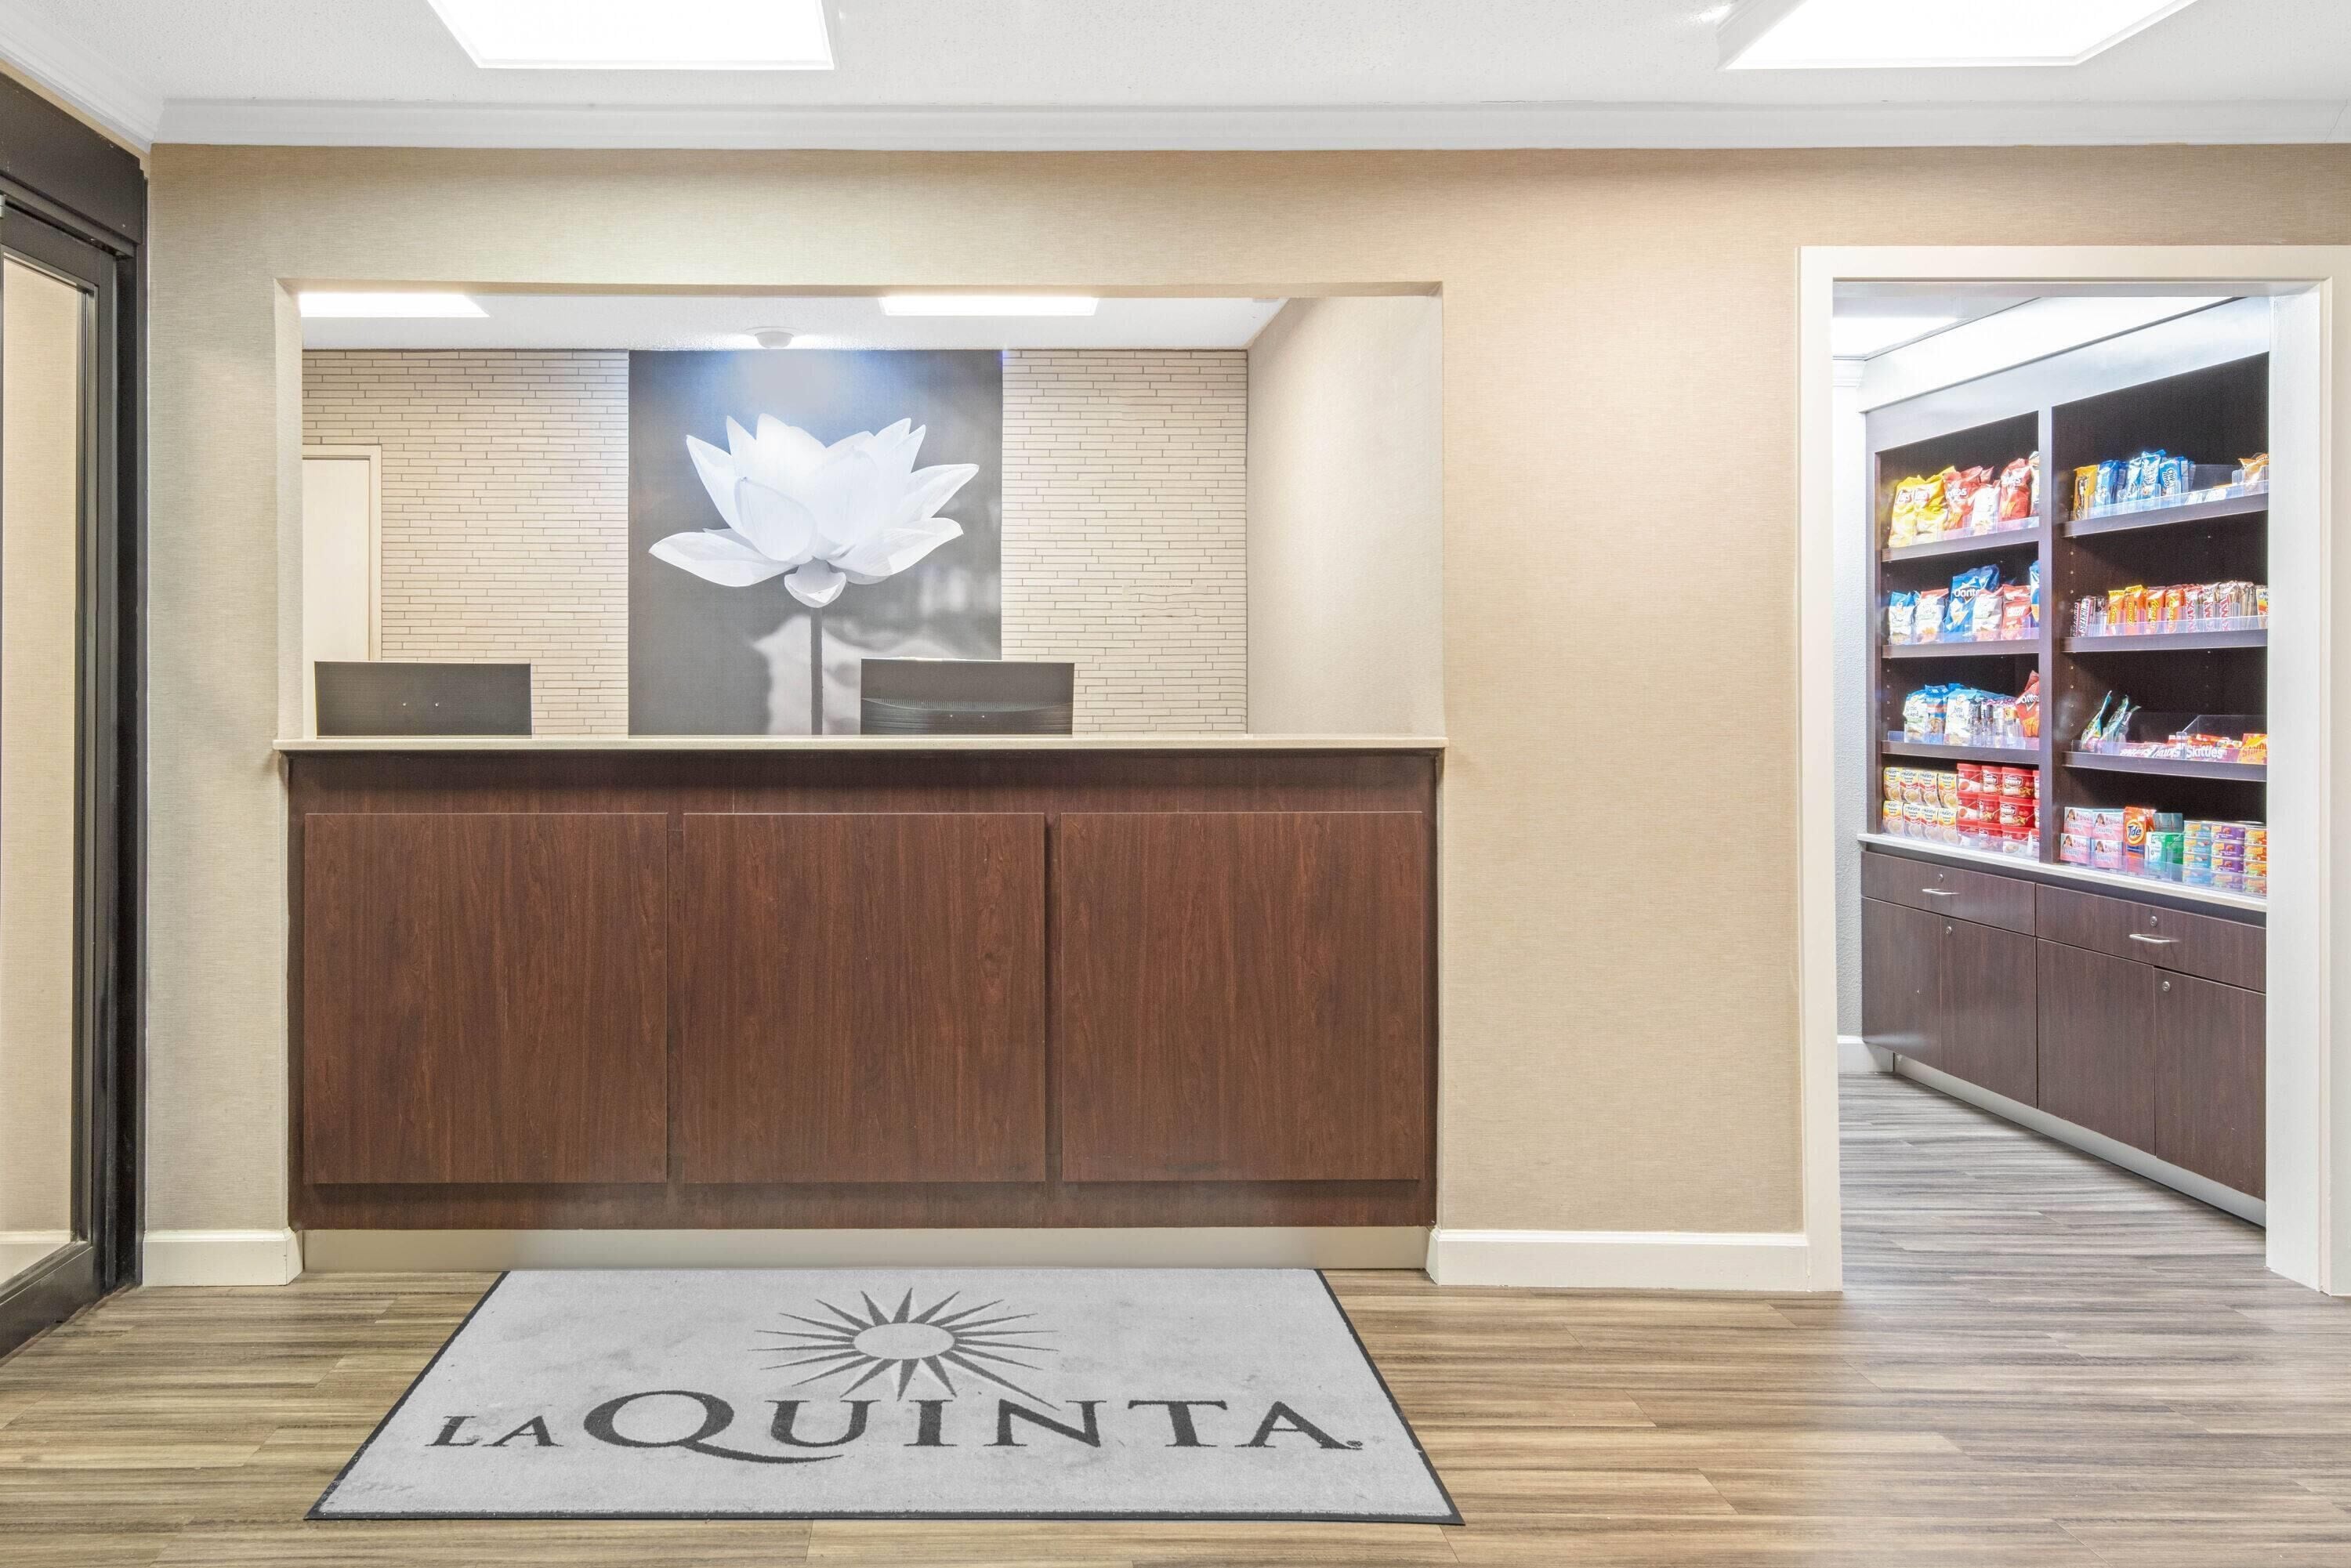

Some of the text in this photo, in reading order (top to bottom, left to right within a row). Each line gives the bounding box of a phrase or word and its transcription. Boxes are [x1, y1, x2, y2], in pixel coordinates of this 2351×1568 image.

[1954, 588, 1980, 598] Dorit
[2079, 599, 2088, 632] ICKERS
[2186, 745, 2224, 759] Skittles
[2127, 825, 2142, 838] Tide
[426, 1390, 1362, 1463] LA QUINTA
